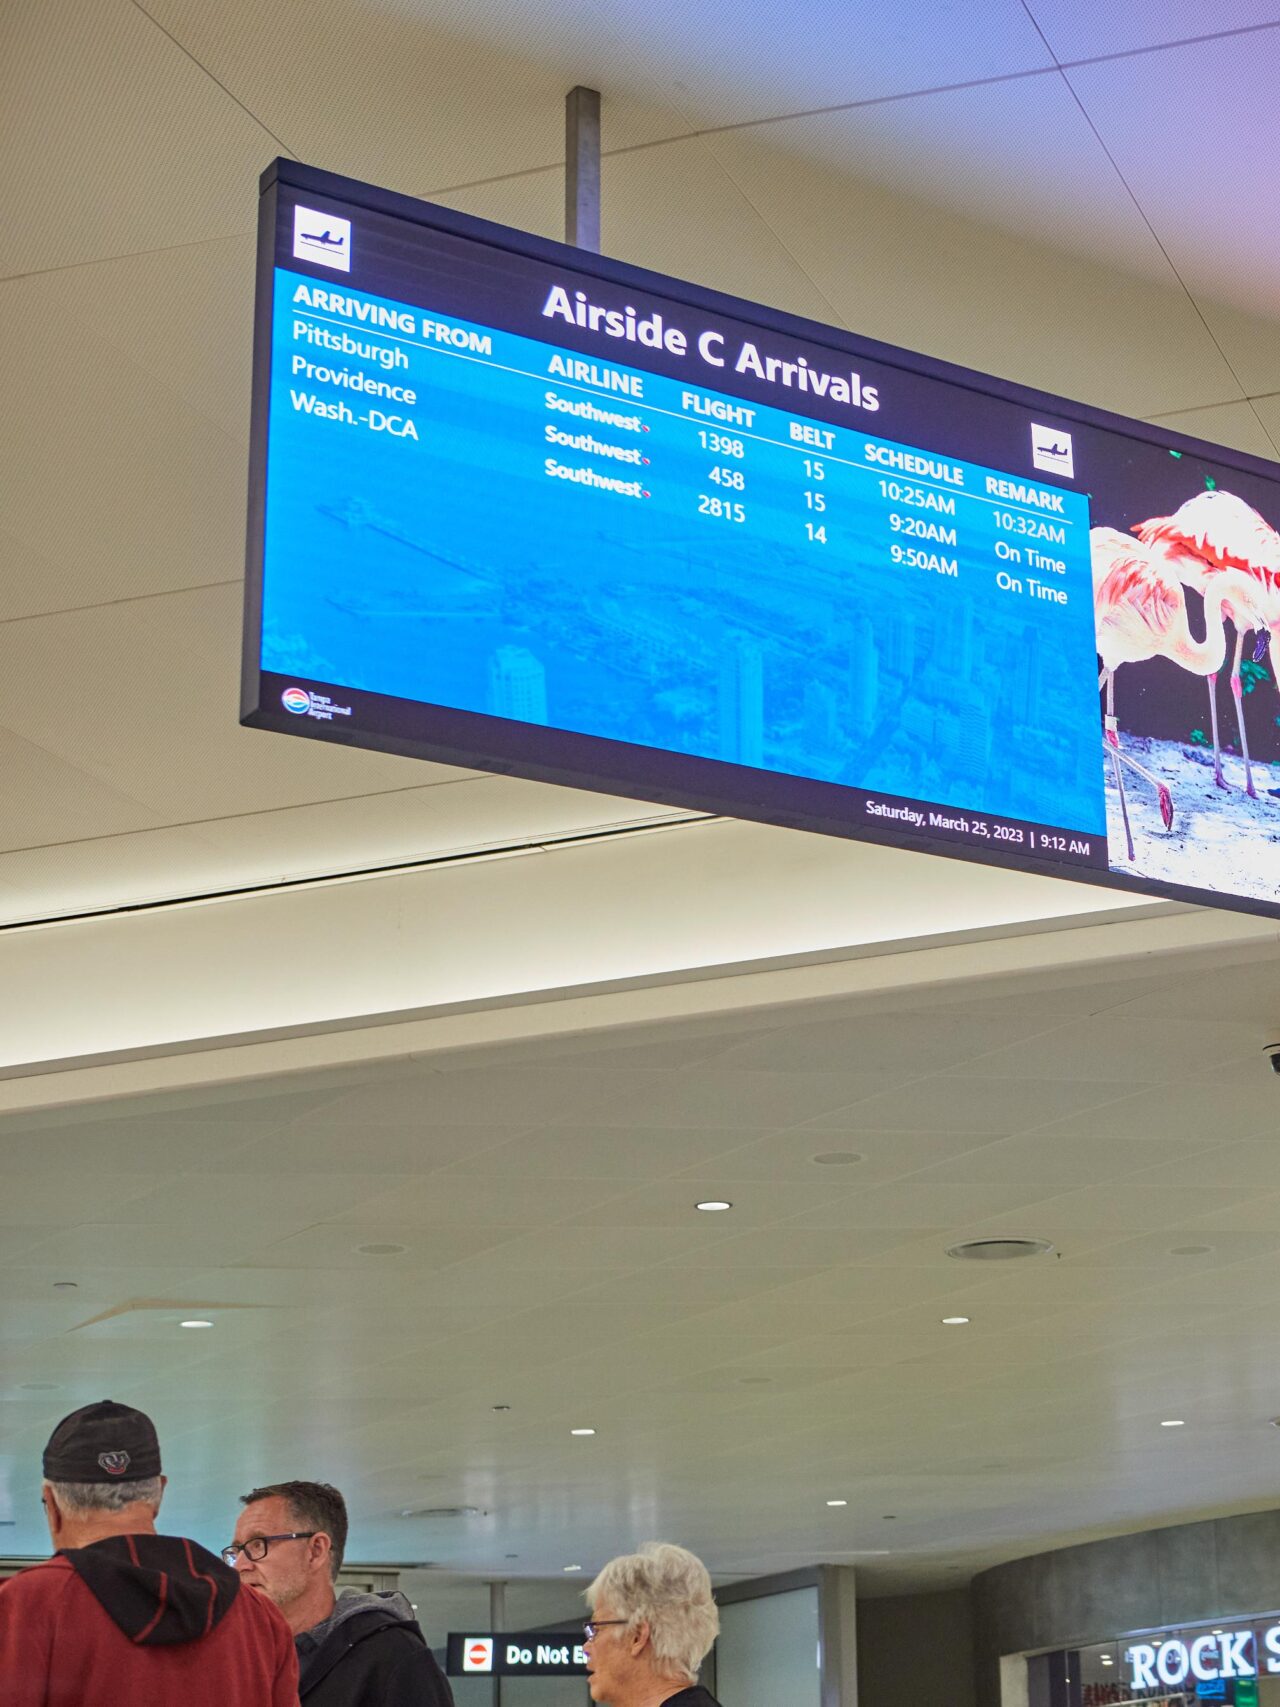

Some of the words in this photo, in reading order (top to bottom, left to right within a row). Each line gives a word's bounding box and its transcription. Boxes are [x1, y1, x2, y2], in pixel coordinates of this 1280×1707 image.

[293, 285, 416, 334] ARRIVING
[422, 320, 493, 356] FROM
[292, 320, 409, 370] Pittsburgh
[542, 285, 687, 356] Airside
[698, 331, 724, 367] C
[735, 342, 880, 412] Arrivals
[292, 355, 417, 406] Providence
[548, 354, 644, 398] AIRLINE
[290, 389, 419, 441] Wash.-DCA
[545, 391, 643, 433] Southwest
[682, 391, 756, 428] FLIGHT
[545, 425, 643, 466] Southwest
[698, 430, 745, 459] 1398
[789, 421, 836, 450] BELT
[545, 458, 643, 499] Southwest
[708, 465, 745, 491] 458
[803, 459, 825, 482] 15
[864, 443, 964, 486] SCHEDULE
[698, 494, 746, 524] 2815
[803, 490, 826, 514] 15
[878, 479, 955, 516] 10:25AM
[986, 476, 1065, 514] REMARK
[804, 521, 828, 545] 14
[889, 513, 957, 547] 9:20AM
[993, 510, 1065, 546] 10:32AM
[890, 544, 959, 578] 9:50AM
[994, 540, 1021, 563] On
[1026, 549, 1066, 575] Time
[996, 571, 1023, 595] On
[1027, 580, 1068, 605] Time
[865, 800, 927, 827] Saturday,
[929, 812, 969, 832] March
[971, 820, 991, 839] 25,
[993, 825, 1024, 843] 2023
[1041, 834, 1066, 851] 9:12
[1069, 839, 1090, 856] AM
[506, 1645, 533, 1664] Do
[536, 1645, 569, 1664] Not
[1128, 1631, 1255, 1689] ROCK
